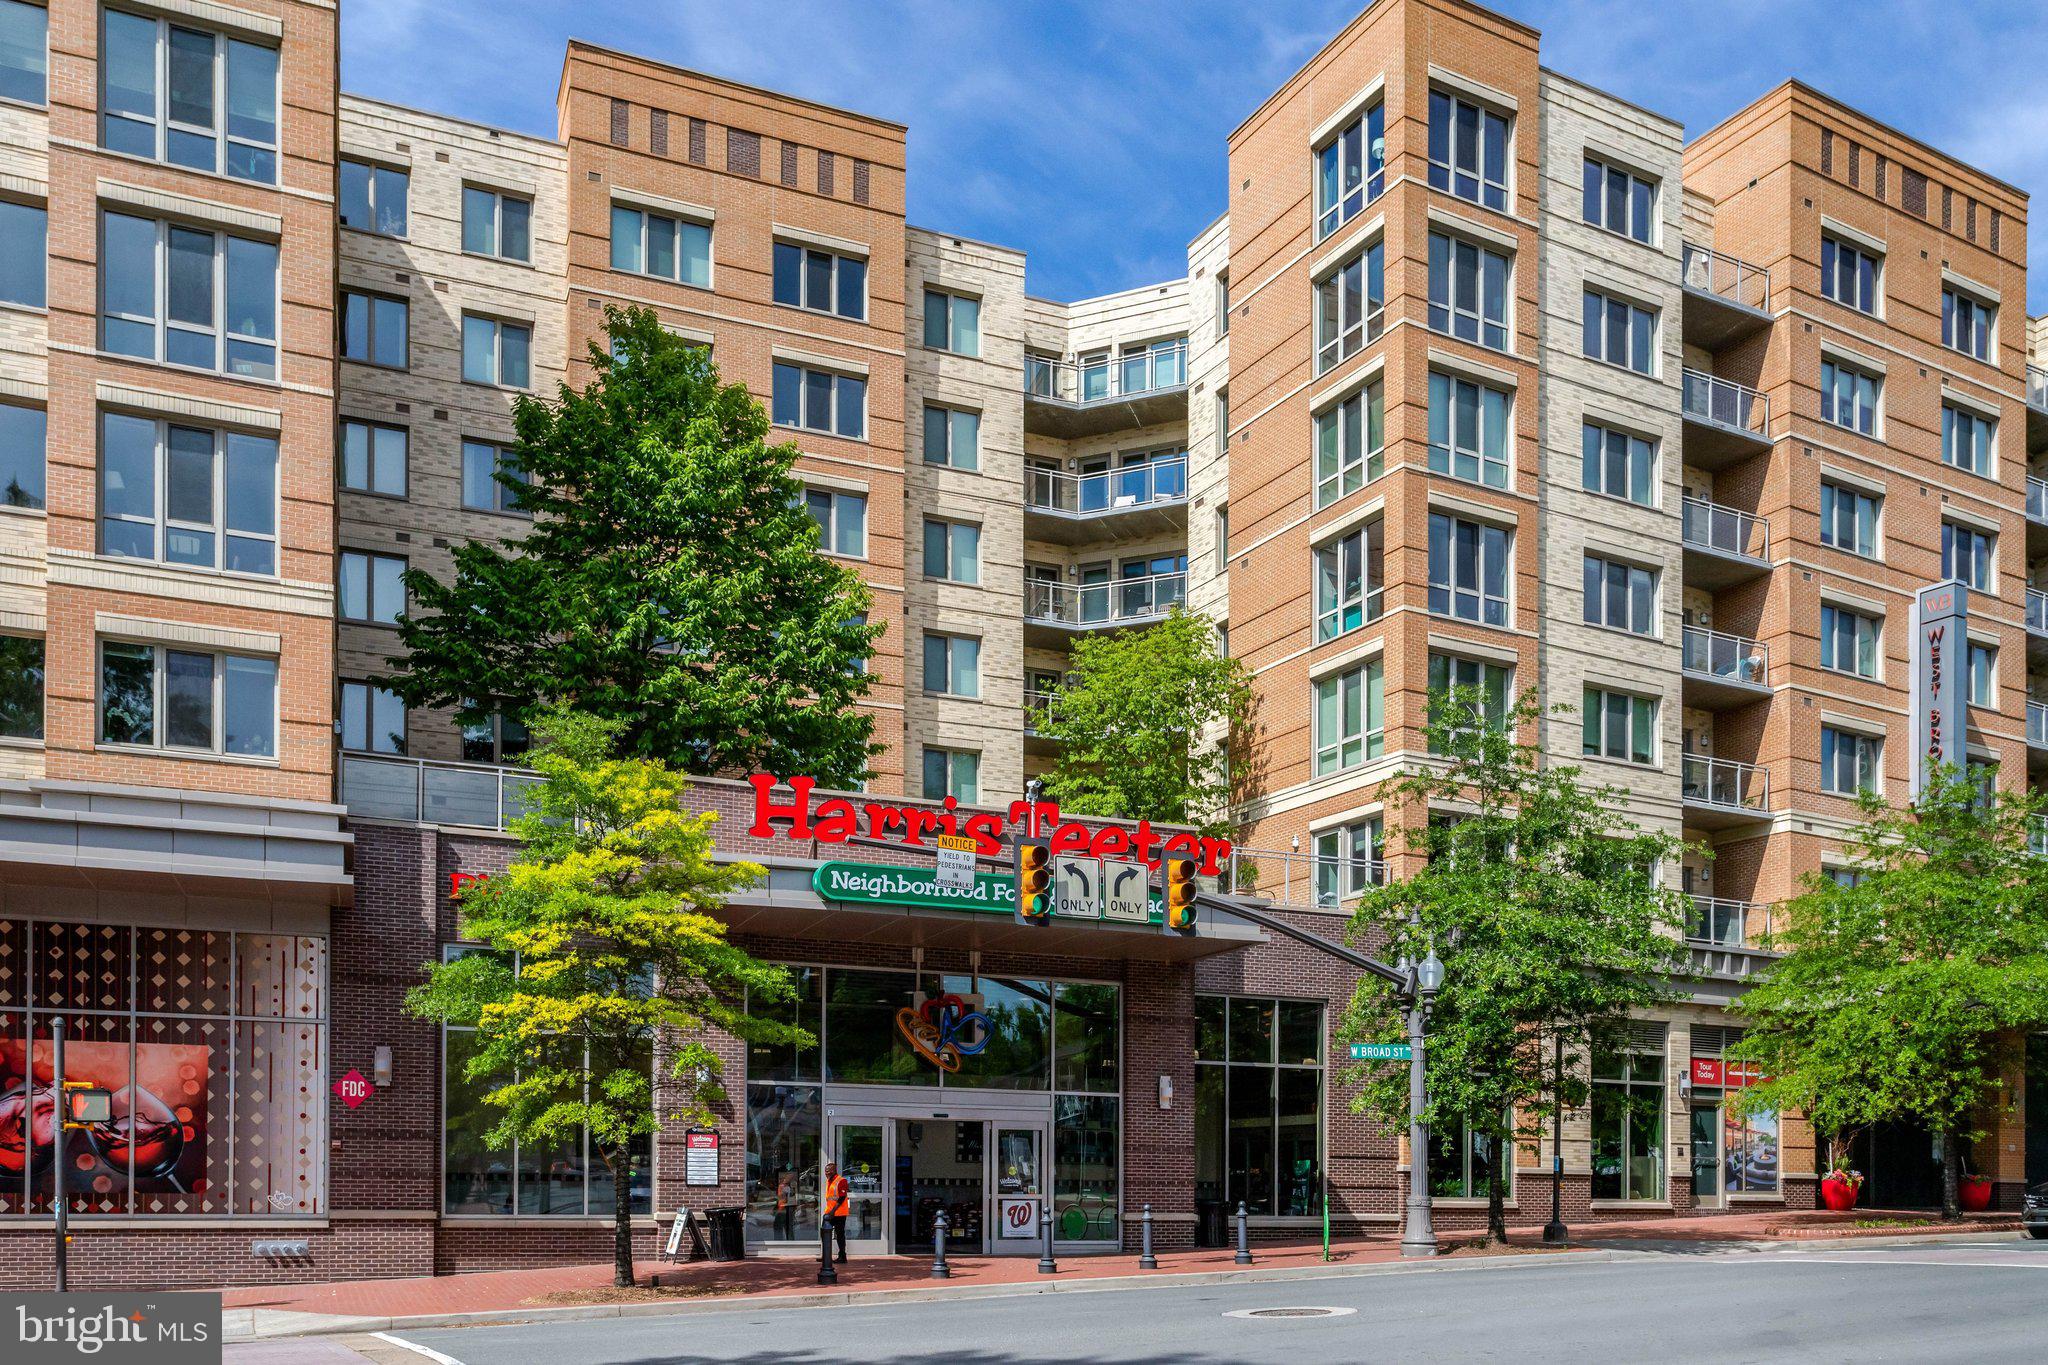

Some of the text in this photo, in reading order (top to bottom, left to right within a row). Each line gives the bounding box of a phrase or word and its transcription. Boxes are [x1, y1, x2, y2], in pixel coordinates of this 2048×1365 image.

[749, 774, 1003, 856] Harris
[941, 837, 974, 850] NOTICE
[944, 852, 960, 861] YIELD
[937, 860, 976, 872] PEDESTRIANS
[936, 878, 973, 889] CROSSWALKS
[1061, 900, 1094, 912] ONLY
[1110, 900, 1142, 914] ONLY
[1351, 1047, 1358, 1056] W
[1361, 1047, 1391, 1057] BROAD
[1393, 1047, 1404, 1057] ST
[1699, 1062, 1712, 1071] Tour
[1696, 1070, 1715, 1080] Today
[342, 1081, 365, 1097] FDC
